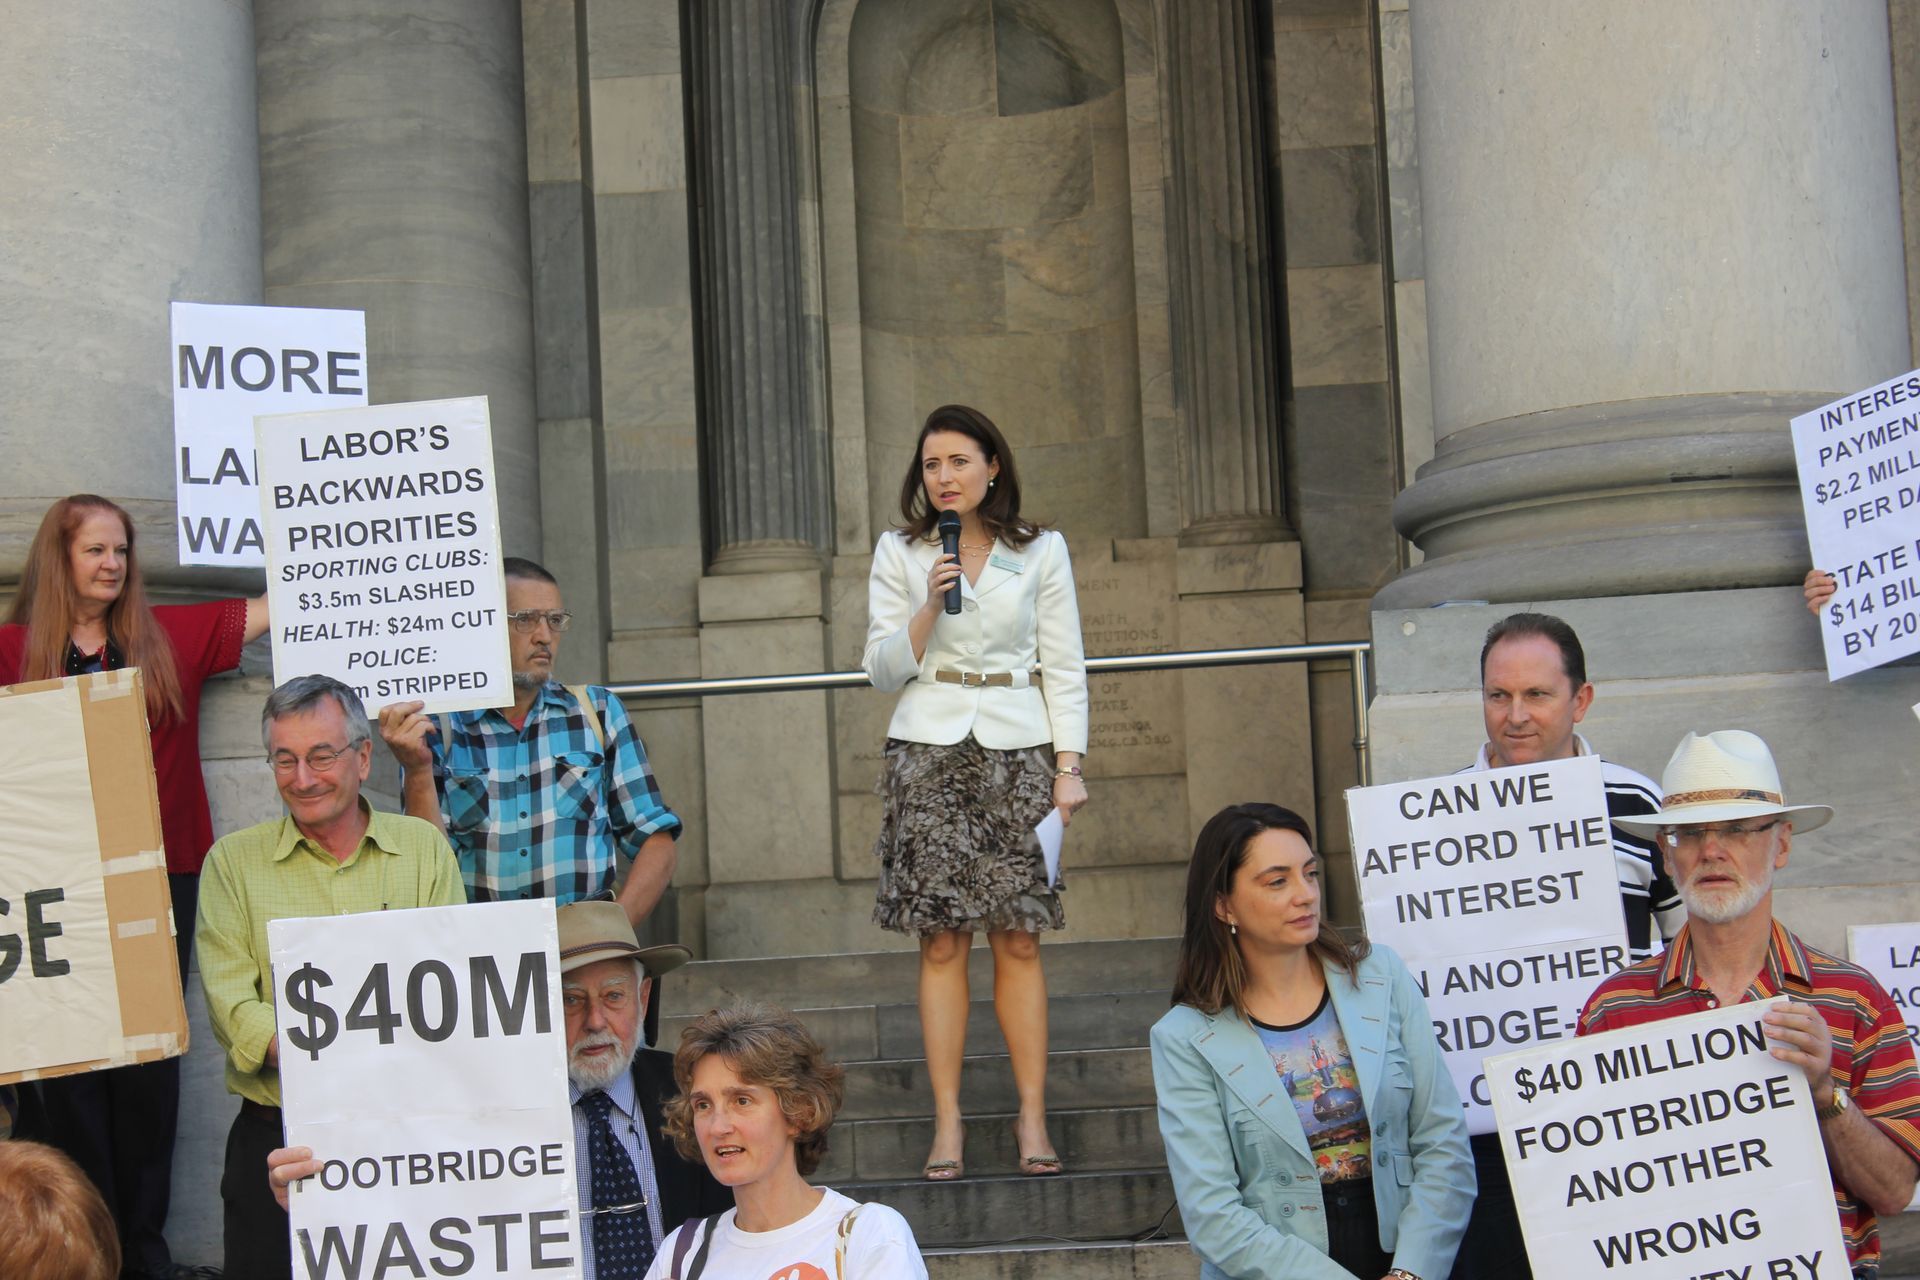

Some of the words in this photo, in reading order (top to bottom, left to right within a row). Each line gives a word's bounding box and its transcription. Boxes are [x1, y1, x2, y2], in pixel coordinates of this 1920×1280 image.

[178, 344, 363, 396] MORE
[1820, 376, 1920, 433] INTERES
[300, 424, 449, 462] LABOR'S
[1819, 410, 1920, 467] PAYMEN
[181, 446, 258, 486] LA
[273, 468, 484, 509] BACKWARDS
[1815, 472, 1861, 504] $2.2
[1868, 450, 1920, 485] MILL
[1843, 496, 1892, 529] PER
[1899, 485, 1920, 509] D
[288, 511, 478, 552] PRIORITIES
[281, 556, 398, 582] SPORTING
[405, 548, 489, 571] CLUBS:
[299, 591, 362, 611] $3.5m
[369, 580, 475, 604] SLASHED
[1830, 593, 1875, 627] $14
[283, 620, 381, 644] HEALTH:
[387, 615, 444, 636] $24m
[451, 609, 497, 629] CUT
[1844, 624, 1879, 656] BY
[1888, 611, 1920, 641] 20
[347, 647, 438, 669] POLICE:
[377, 671, 489, 697] STRIPPED
[1101, 682, 1123, 694] OF
[1399, 784, 1480, 820] CAN
[1490, 773, 1553, 807] WE
[1362, 830, 1518, 877] AFFORD
[1529, 816, 1607, 853] THE
[1396, 871, 1584, 923] INTEREST
[1443, 945, 1625, 996] ANOTHER
[285, 951, 552, 1061] $40M
[1514, 1060, 1582, 1103] $40
[1594, 1021, 1768, 1084] MILLION
[1515, 1075, 1795, 1159] FOOTBRIDGE
[1567, 1138, 1773, 1207] ANOTHER
[296, 1209, 575, 1280] WASTE
[1593, 1208, 1761, 1268] WRONG
[1767, 1250, 1823, 1280] BY
